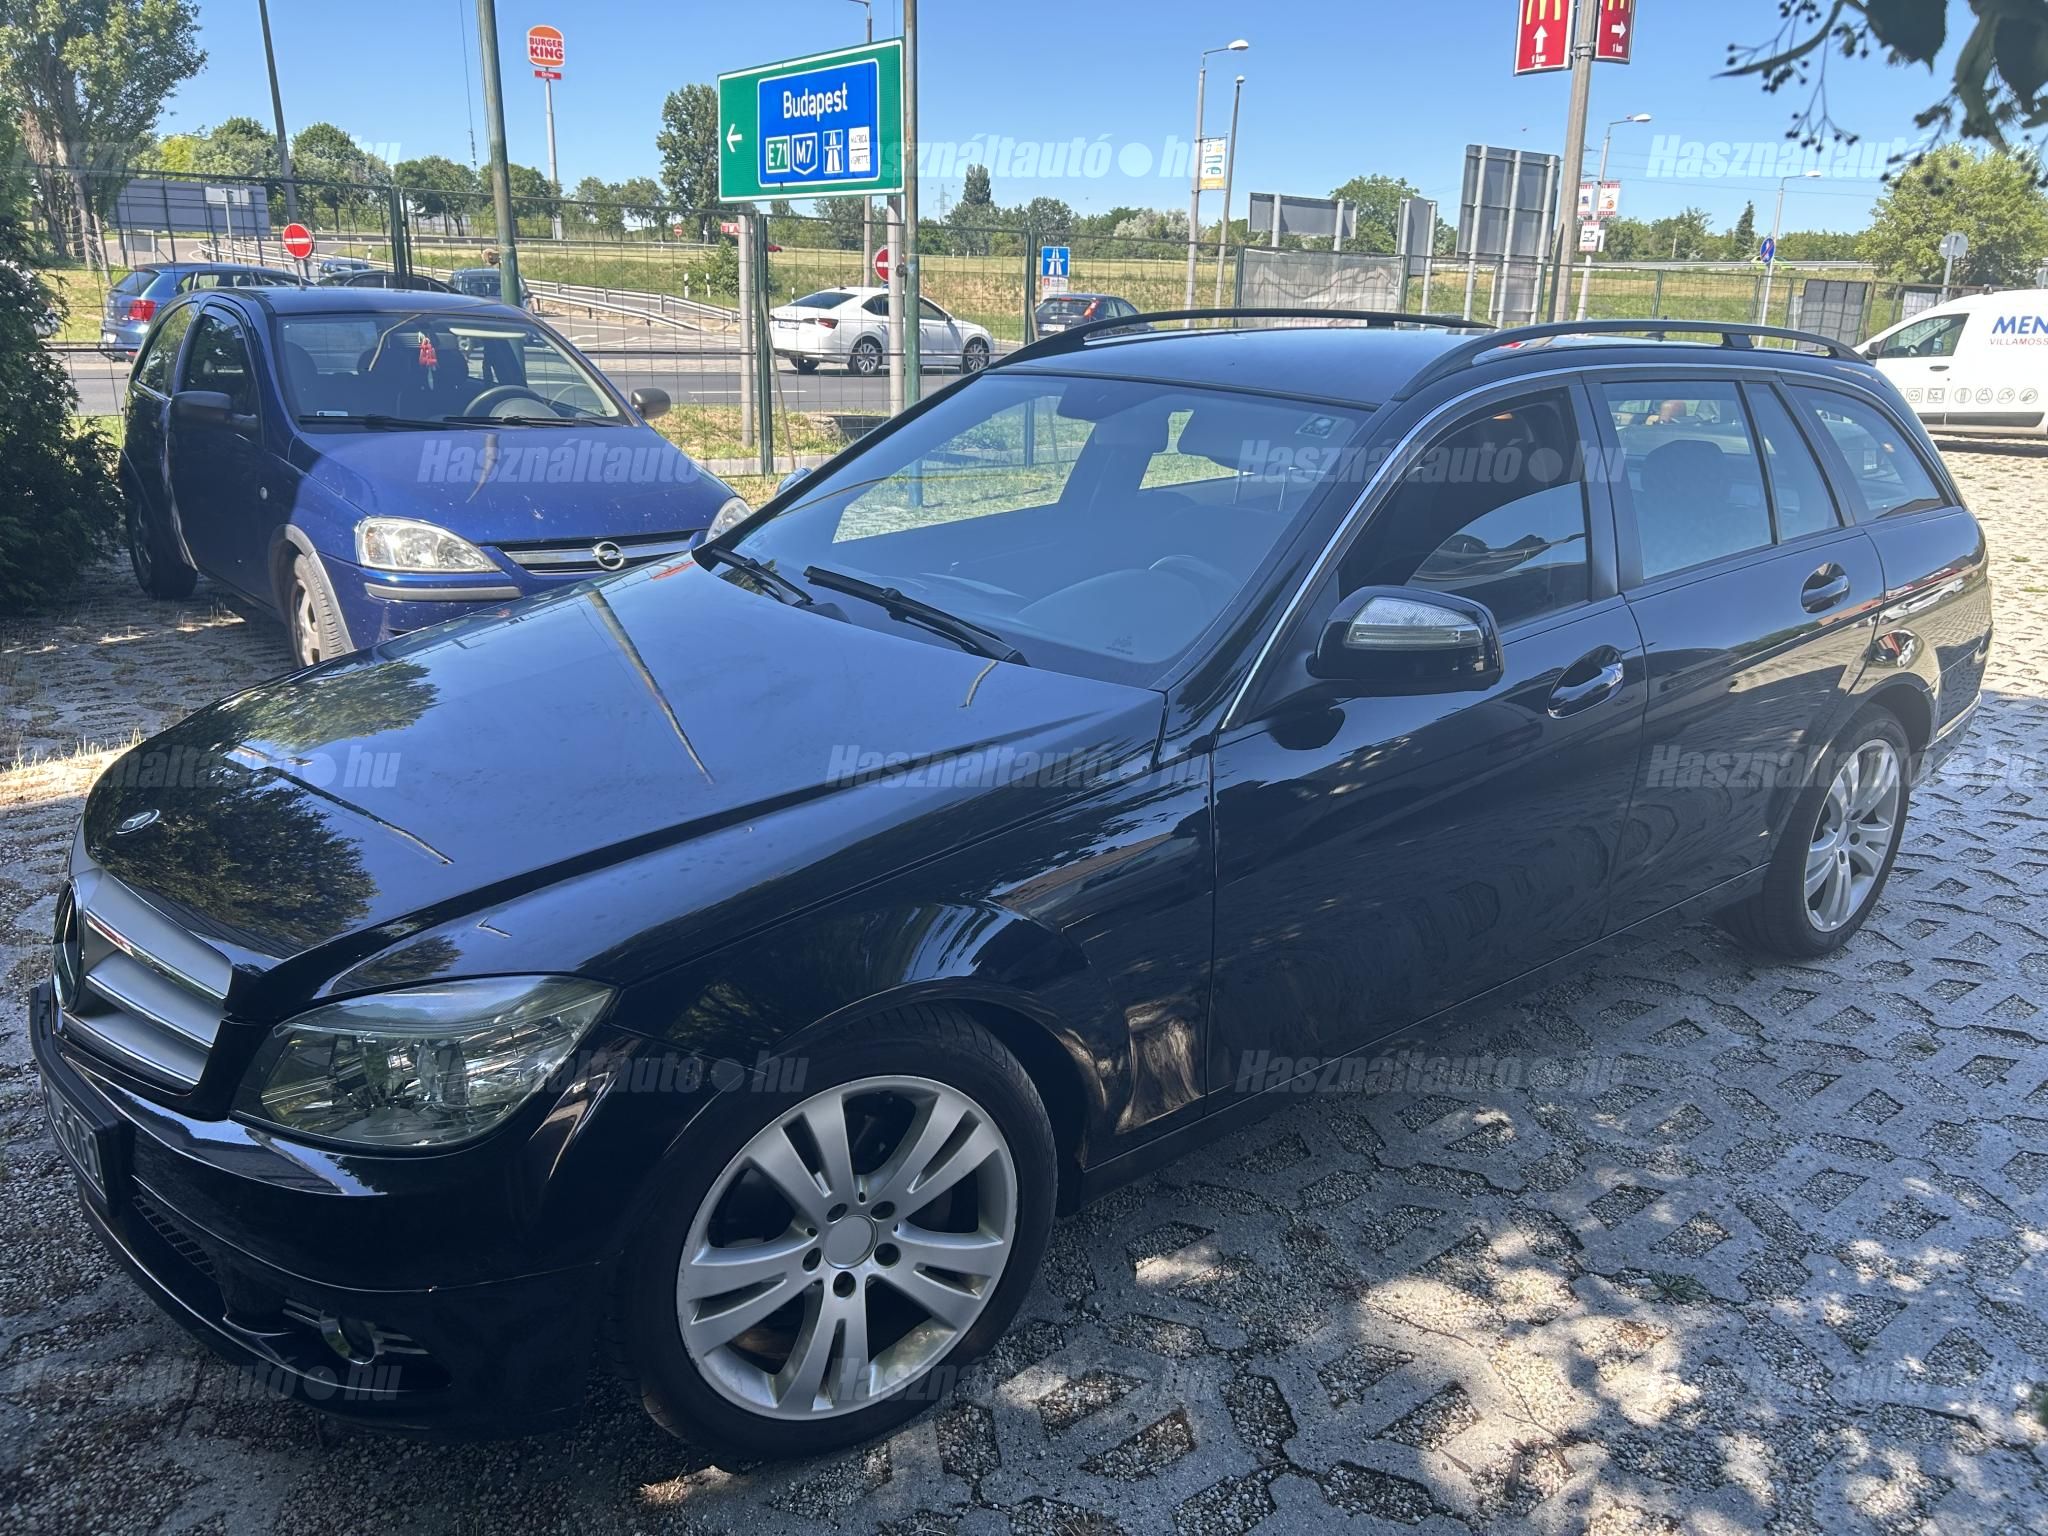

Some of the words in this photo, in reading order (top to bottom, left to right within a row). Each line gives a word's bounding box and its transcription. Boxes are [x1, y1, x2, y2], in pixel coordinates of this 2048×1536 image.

[529, 37, 562, 48] BURGER
[530, 46, 563, 59] KING
[783, 82, 848, 122] Budapest
[768, 142, 788, 167] E71
[796, 140, 813, 164] M7
[1992, 315, 2048, 334] MEN
